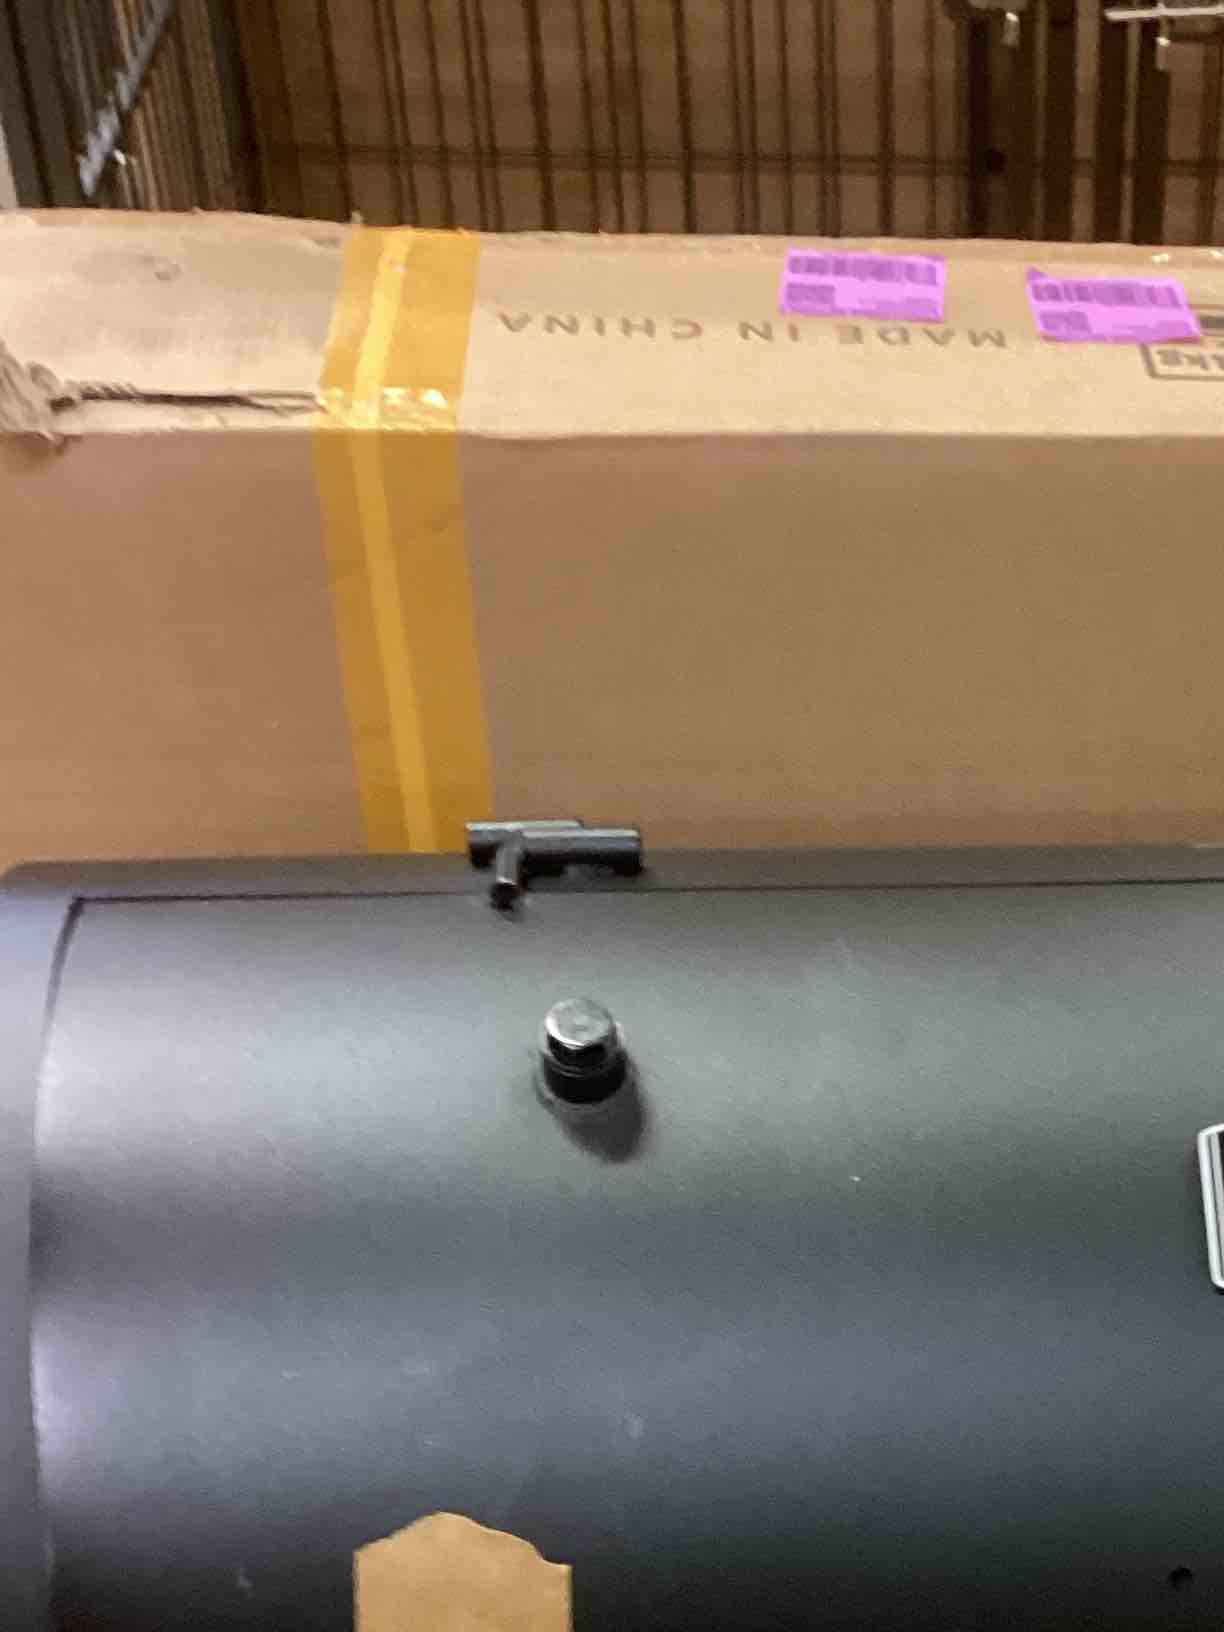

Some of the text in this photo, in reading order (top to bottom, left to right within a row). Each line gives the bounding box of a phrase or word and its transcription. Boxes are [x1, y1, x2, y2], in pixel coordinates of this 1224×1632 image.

[496, 311, 1006, 348] MADE IN CHINA
